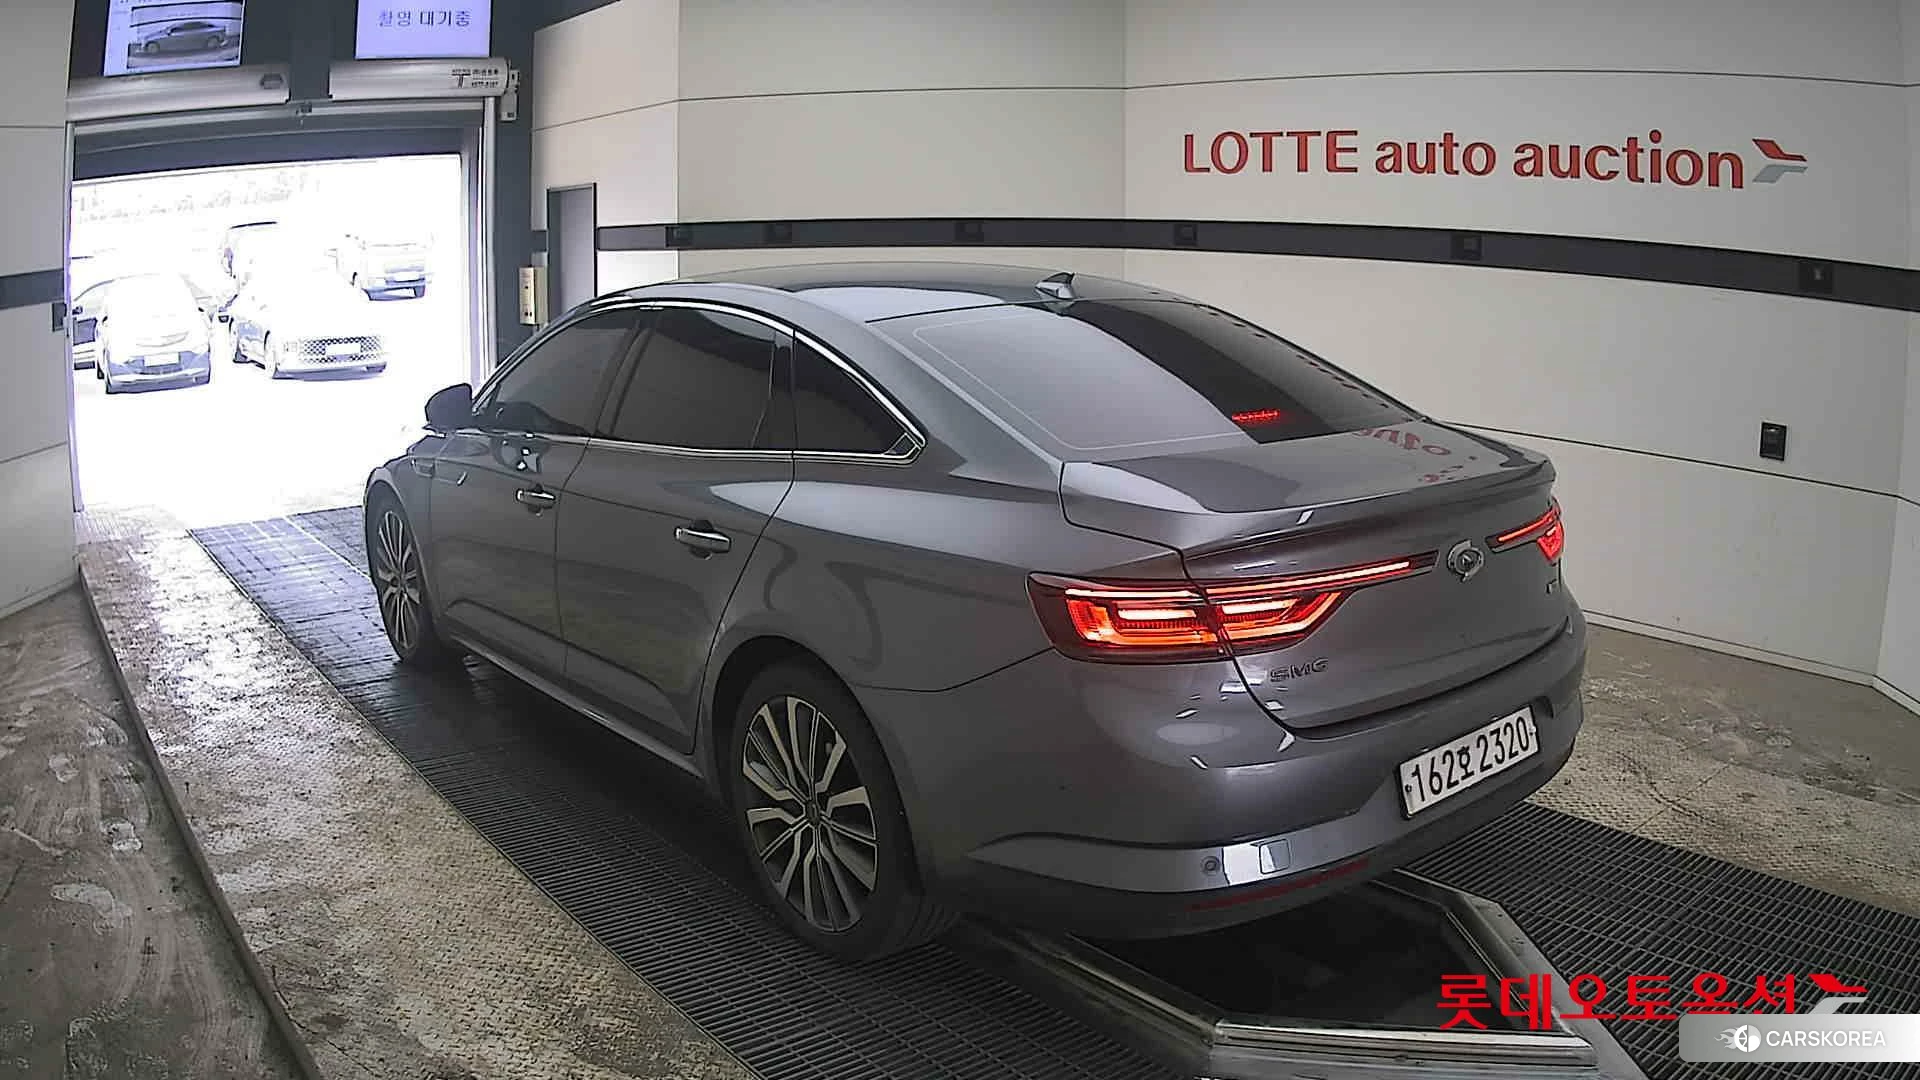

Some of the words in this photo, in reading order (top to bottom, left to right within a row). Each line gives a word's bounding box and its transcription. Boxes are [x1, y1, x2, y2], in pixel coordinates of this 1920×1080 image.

[419, 10, 471, 28] 대기중
[1183, 130, 1359, 174] LOTTE
[1375, 131, 1496, 177] auto
[1513, 129, 1744, 189] auction
